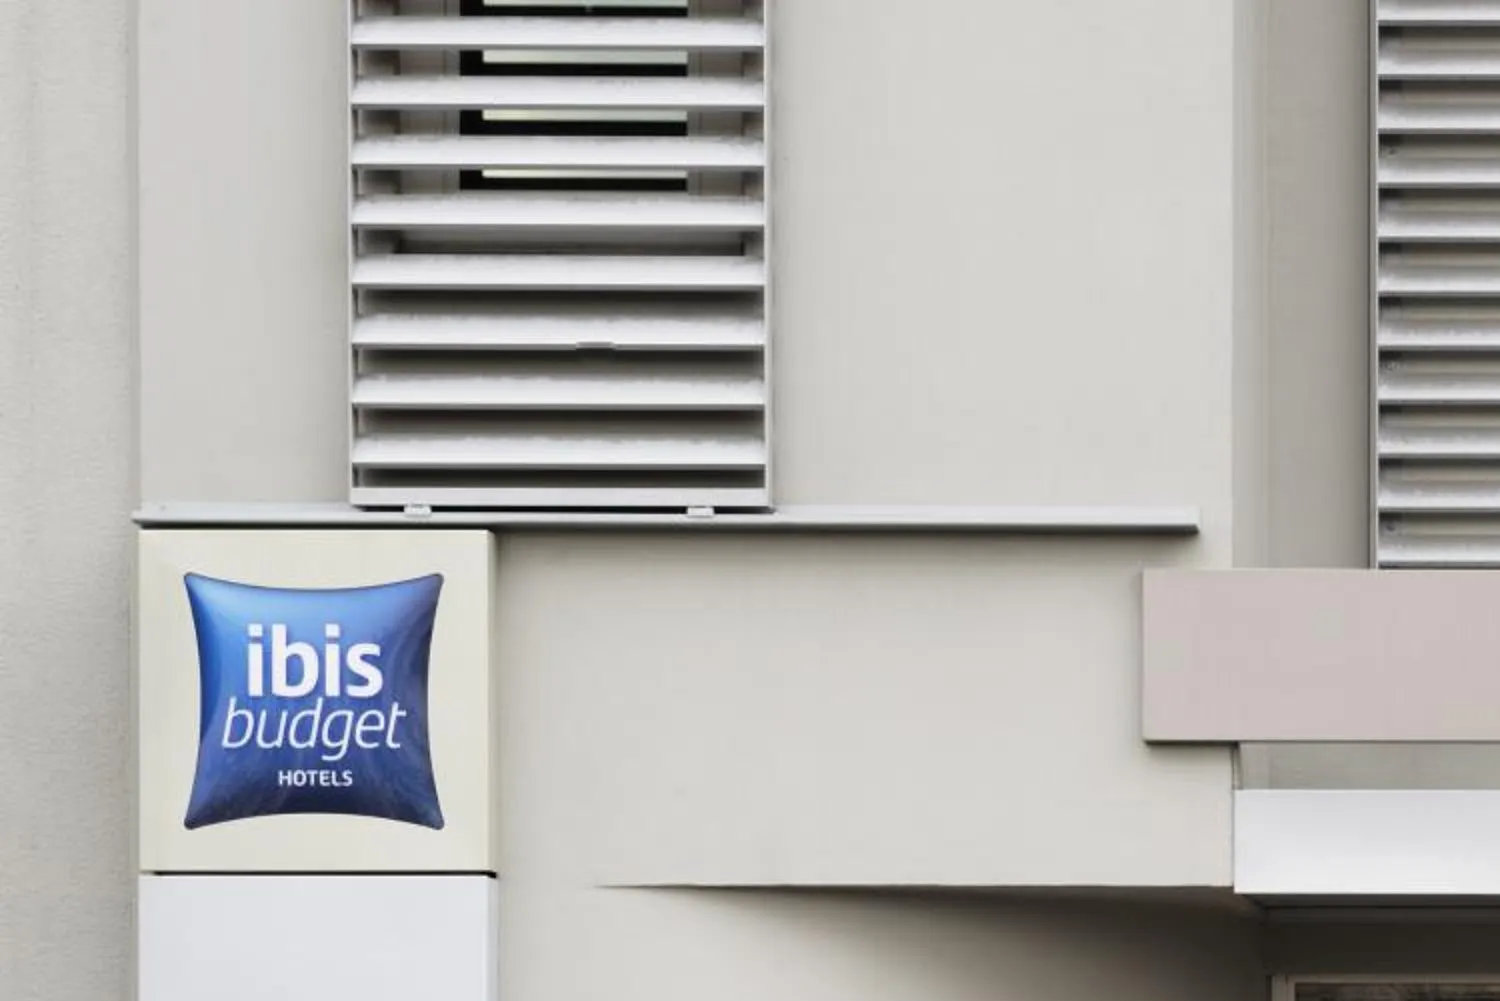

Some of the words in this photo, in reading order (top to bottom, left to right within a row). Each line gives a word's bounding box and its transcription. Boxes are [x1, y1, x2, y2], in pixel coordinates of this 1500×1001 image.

[247, 622, 383, 697] ibis
[221, 696, 407, 761] budget
[278, 769, 353, 787] HOTELS
